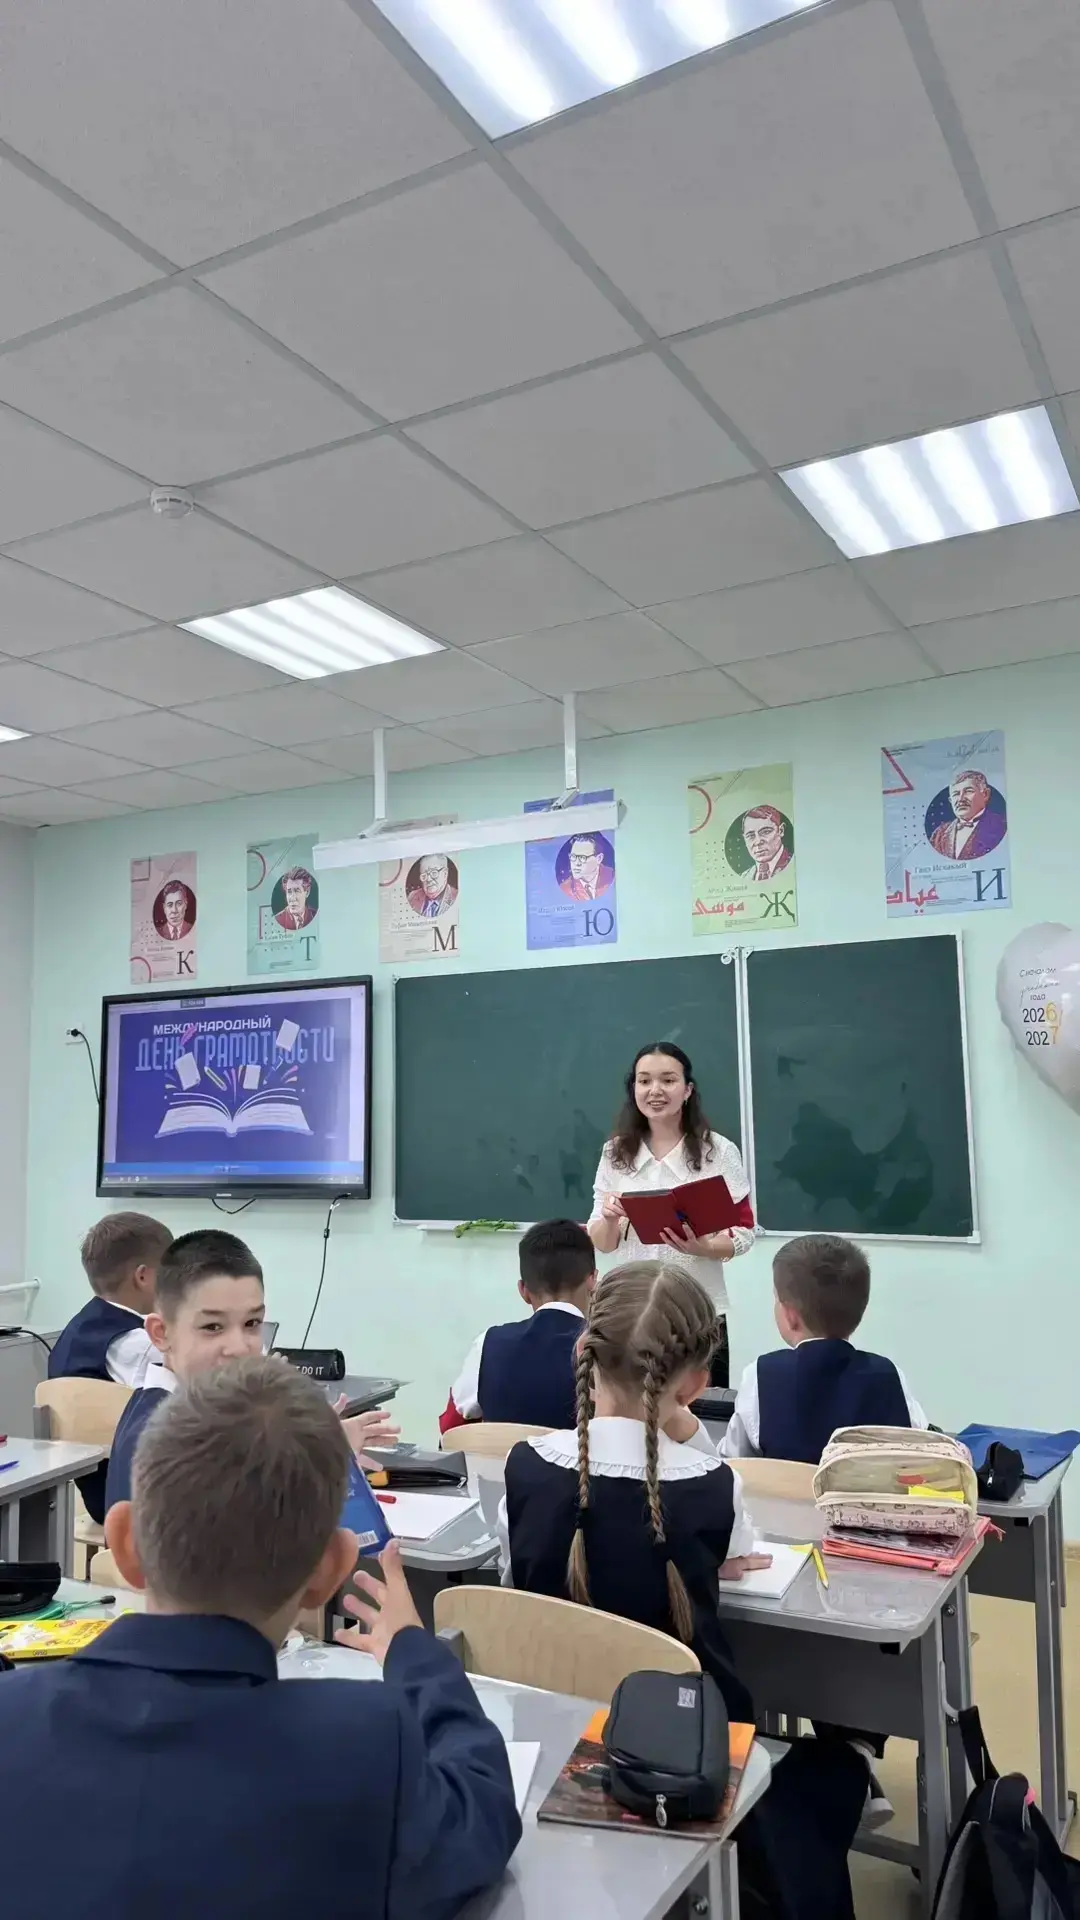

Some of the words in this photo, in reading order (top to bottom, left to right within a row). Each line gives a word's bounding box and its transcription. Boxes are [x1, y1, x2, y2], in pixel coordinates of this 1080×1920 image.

[972, 867, 1007, 902] И
[582, 907, 615, 938] Ю
[300, 936, 317, 961] Т
[432, 924, 458, 952] М
[176, 950, 195, 975] К
[153, 1014, 271, 1035] МЕЖДУНАРОДНЫЙ
[301, 1366, 313, 1375] DO
[315, 1366, 324, 1375] IT
